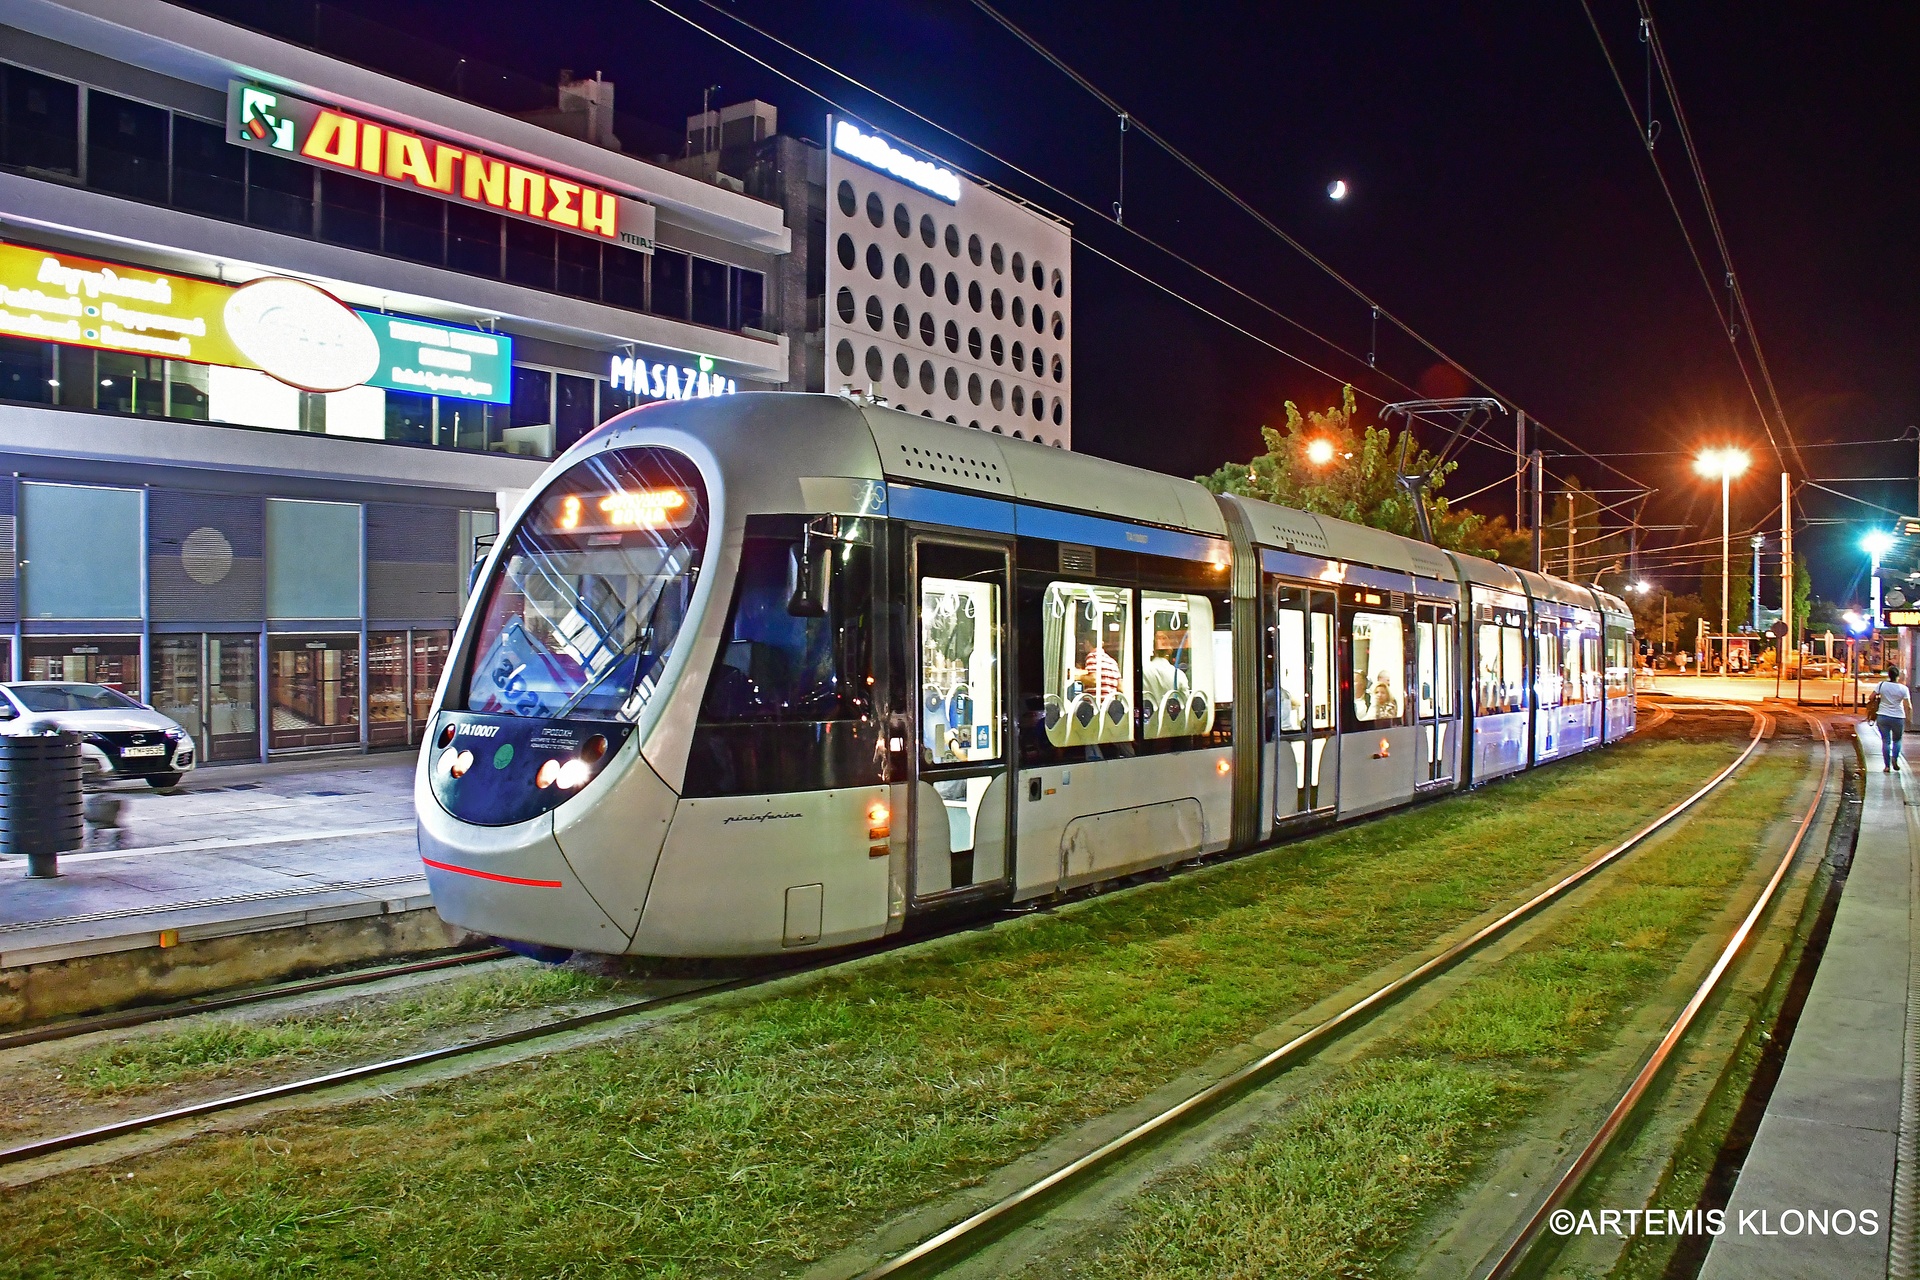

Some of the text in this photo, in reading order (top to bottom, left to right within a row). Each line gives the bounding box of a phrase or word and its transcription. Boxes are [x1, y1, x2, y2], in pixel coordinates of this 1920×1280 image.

[301, 110, 617, 238] ΔΙΑΓΝΩΣΗ
[562, 496, 580, 529] 3
[458, 723, 500, 738] TA10007
[723, 811, 804, 825] pininfarina
